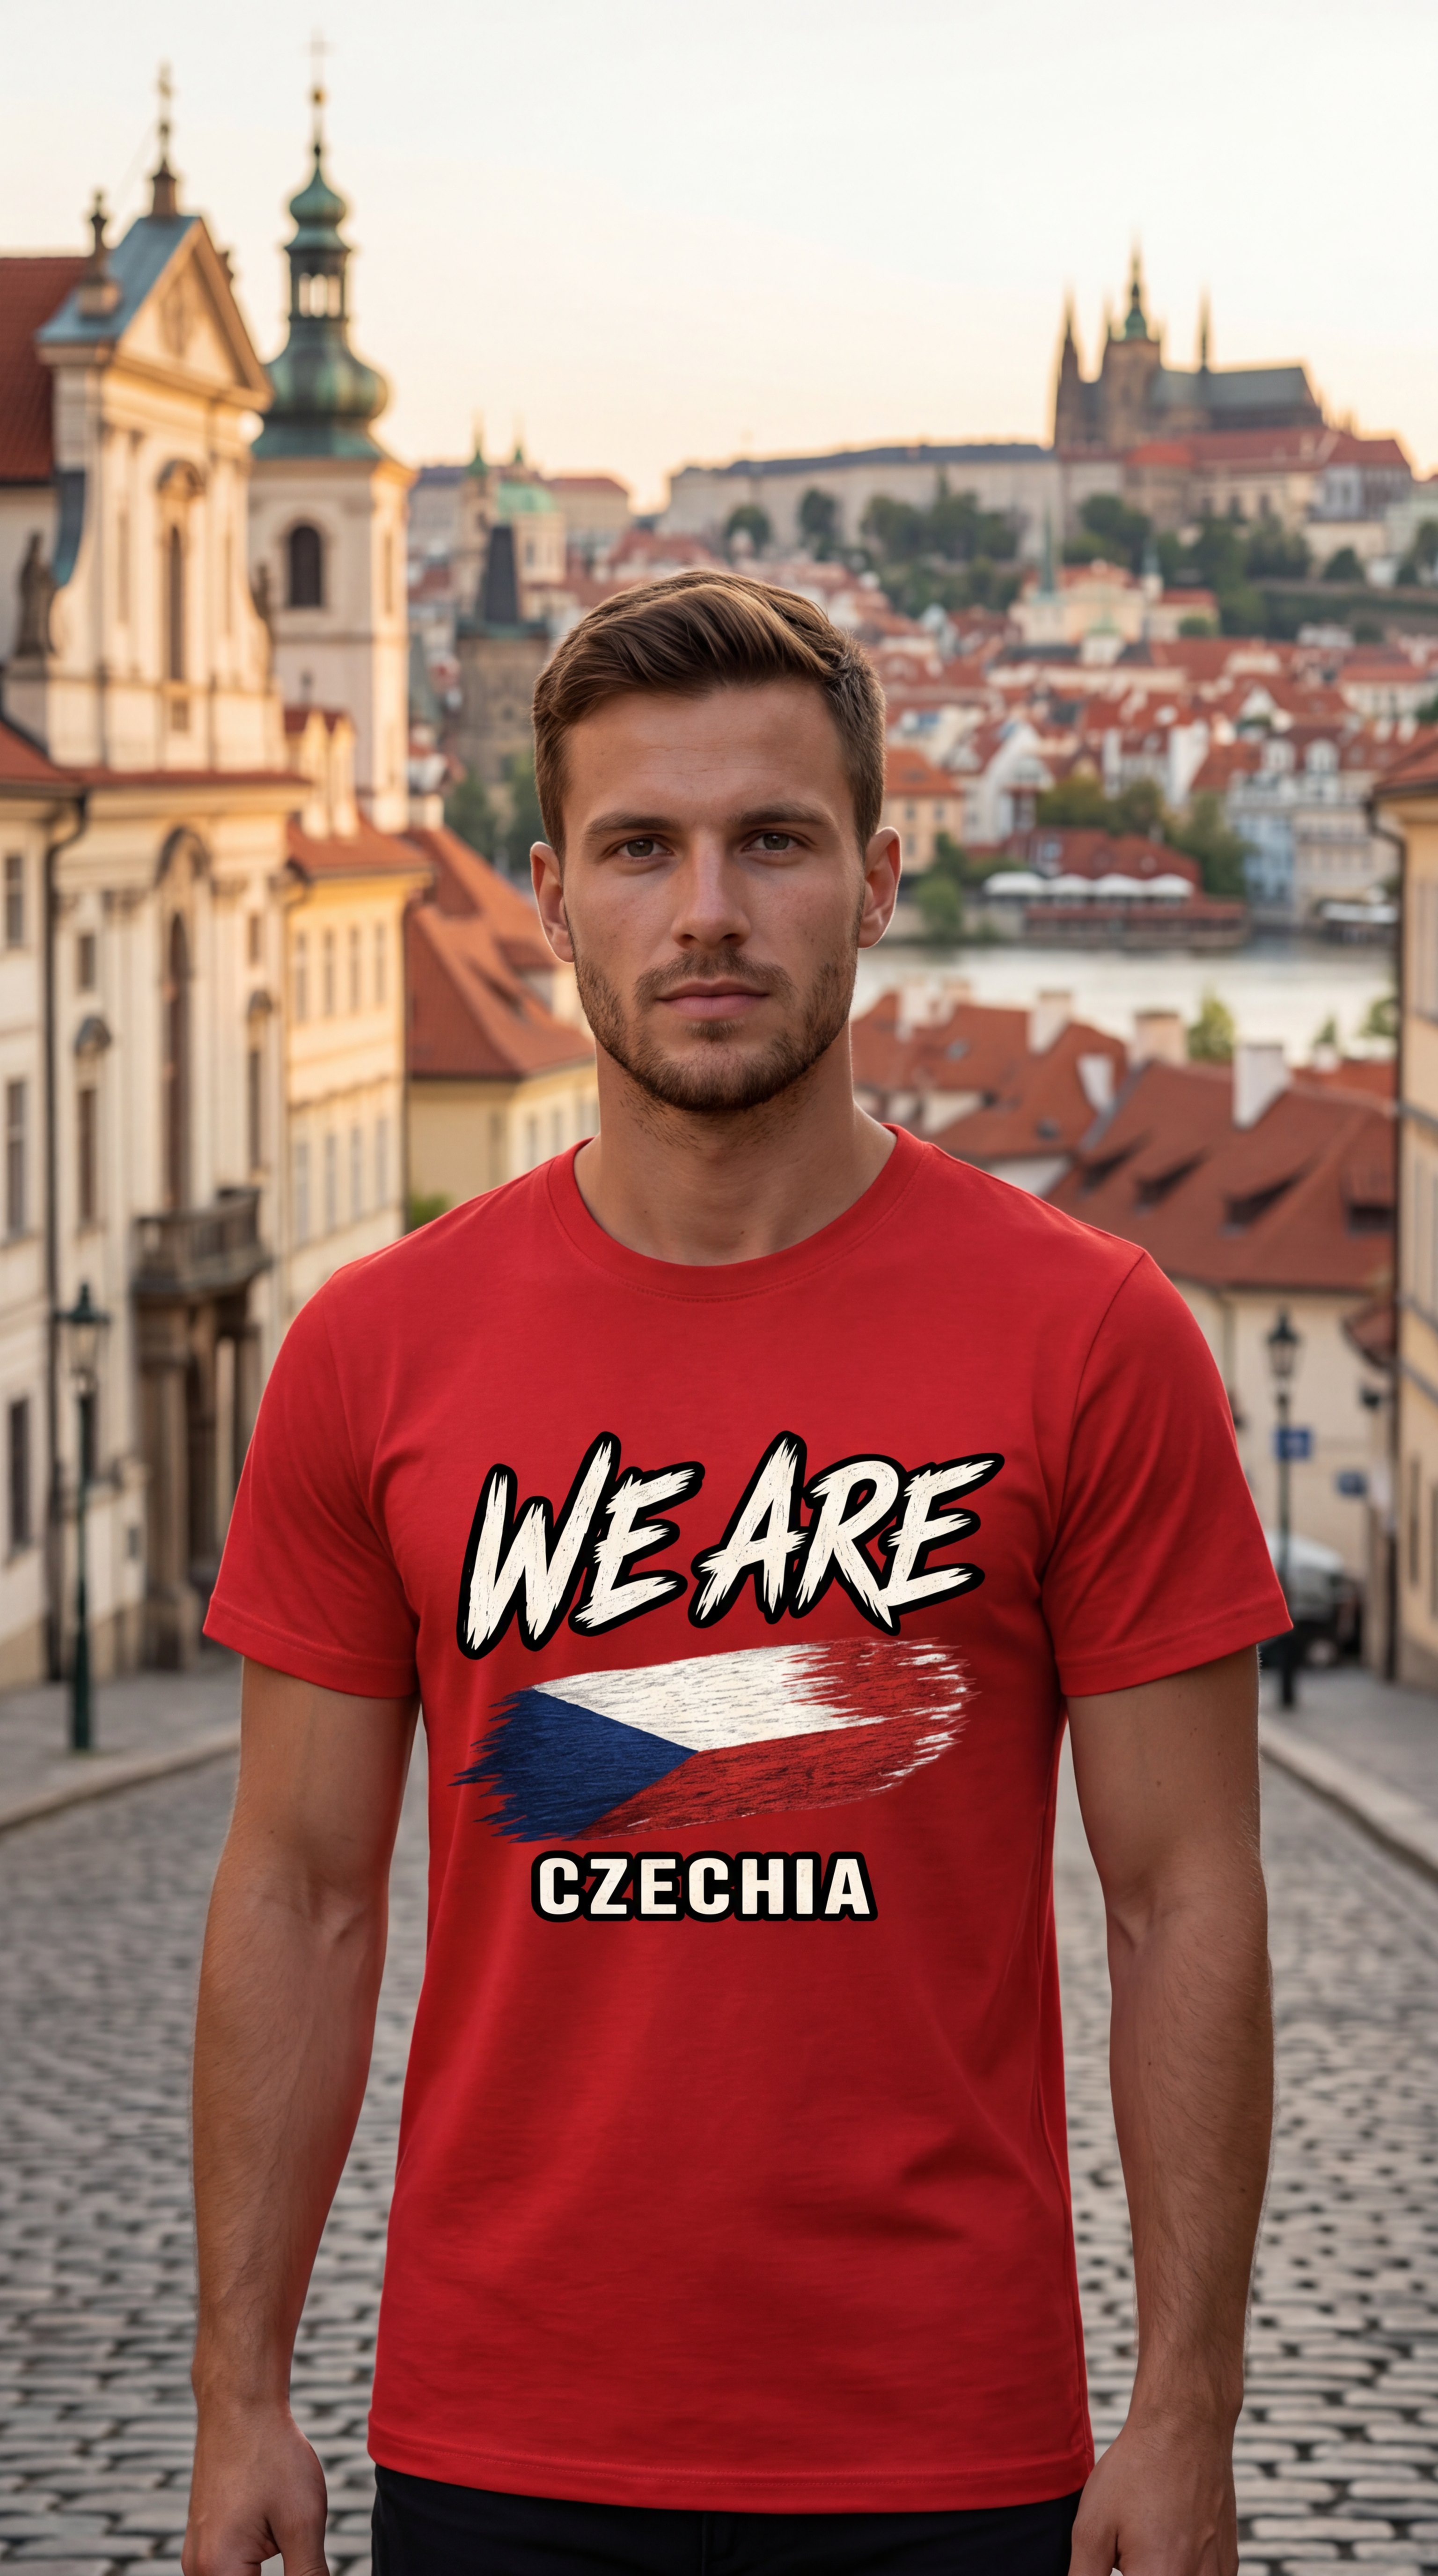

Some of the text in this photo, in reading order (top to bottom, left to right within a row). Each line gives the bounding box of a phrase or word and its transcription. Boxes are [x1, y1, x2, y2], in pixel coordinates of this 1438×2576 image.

[464, 1437, 995, 1651] WE ARE
[539, 1858, 871, 1915] CZECHIA
